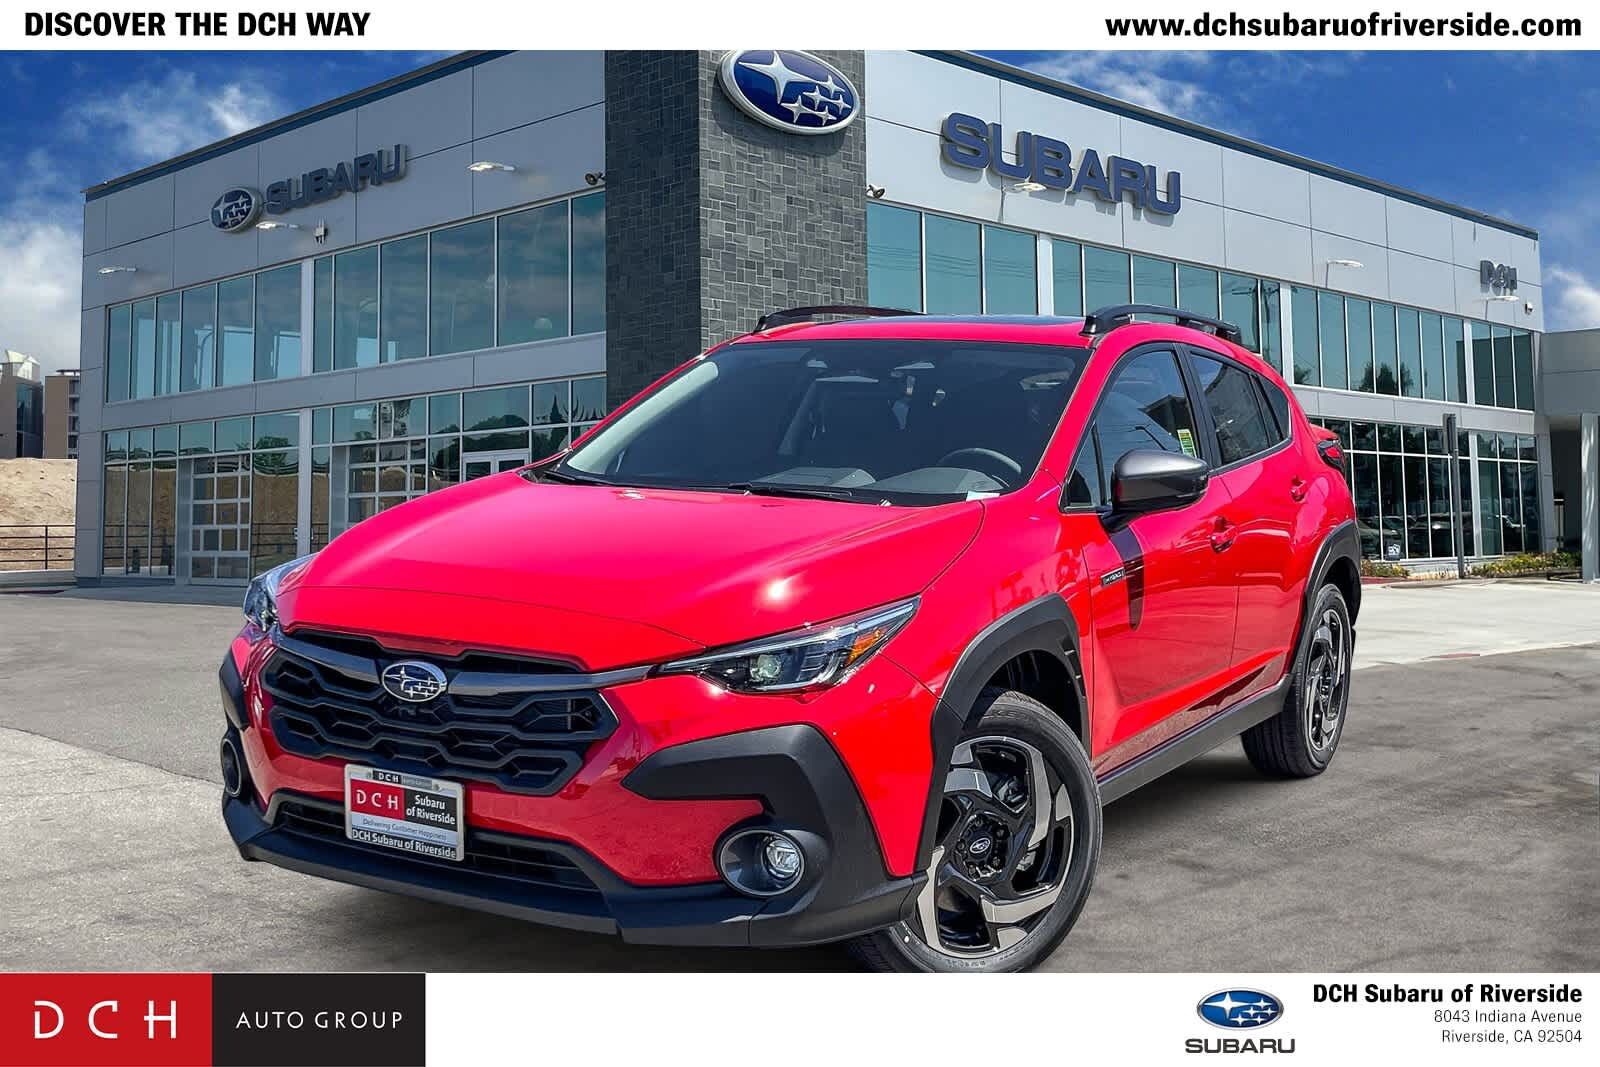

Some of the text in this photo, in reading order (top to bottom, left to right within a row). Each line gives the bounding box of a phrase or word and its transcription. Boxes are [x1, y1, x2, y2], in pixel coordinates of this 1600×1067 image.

[943, 112, 1181, 216] SUBARU
[266, 144, 406, 215] SUBARU
[378, 772, 399, 783] DCH
[356, 789, 399, 811] DCH
[415, 794, 446, 810] Subaru
[406, 806, 456, 825] of Riverside
[352, 827, 457, 858] DCH Subaru of Riverside
